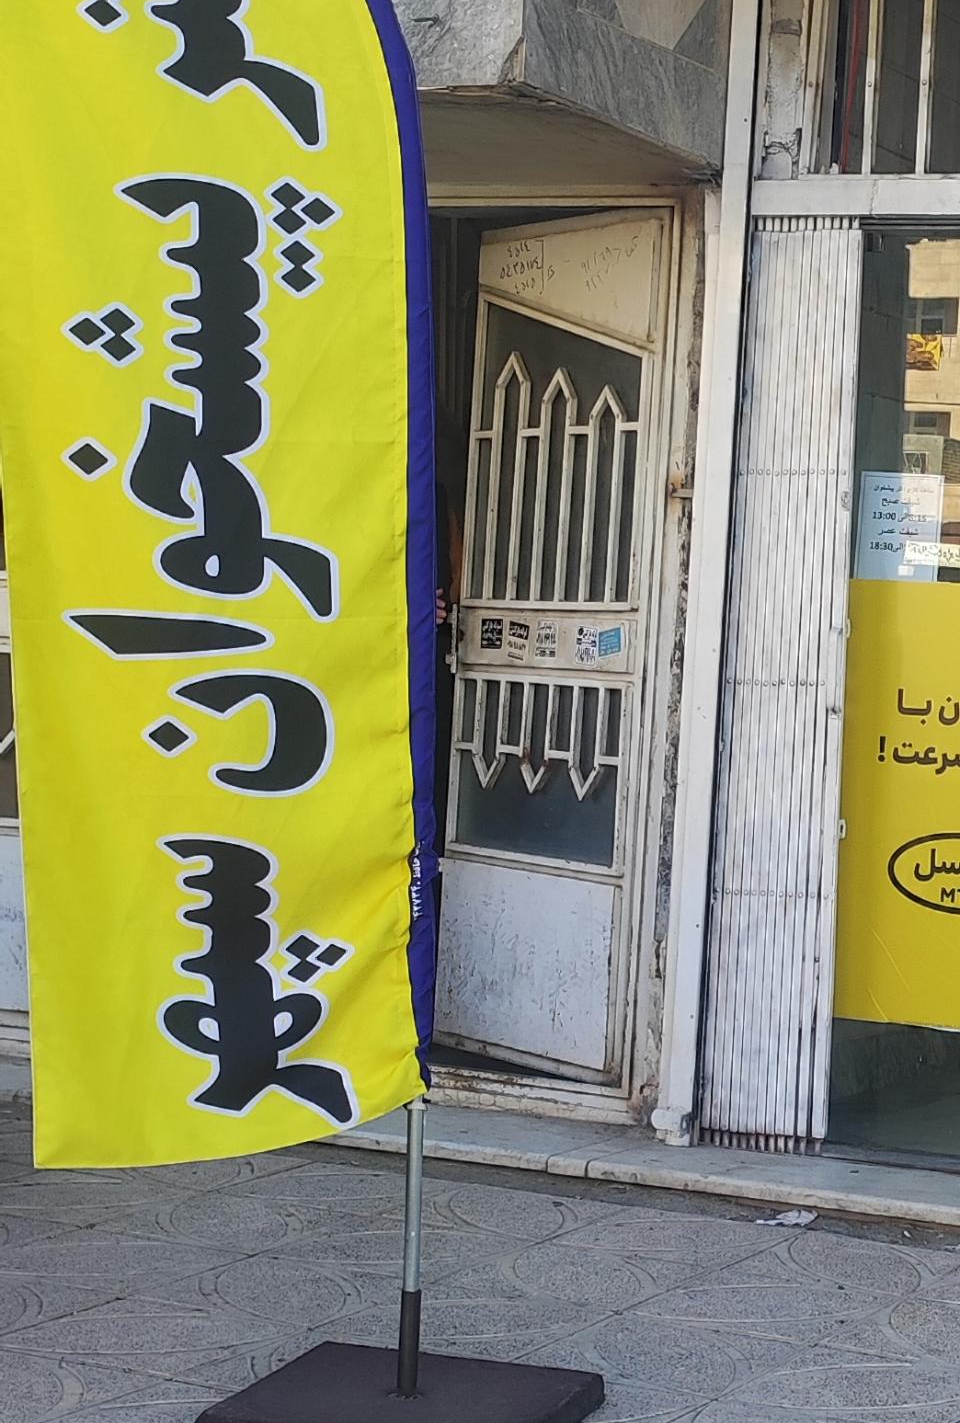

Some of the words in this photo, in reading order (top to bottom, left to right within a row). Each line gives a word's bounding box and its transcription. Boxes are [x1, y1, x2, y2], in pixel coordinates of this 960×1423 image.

[63, 174, 342, 796] پیشخوان
[872, 511, 896, 520] 13:00
[897, 688, 933, 726] با
[156, 834, 360, 1130] سپهر
